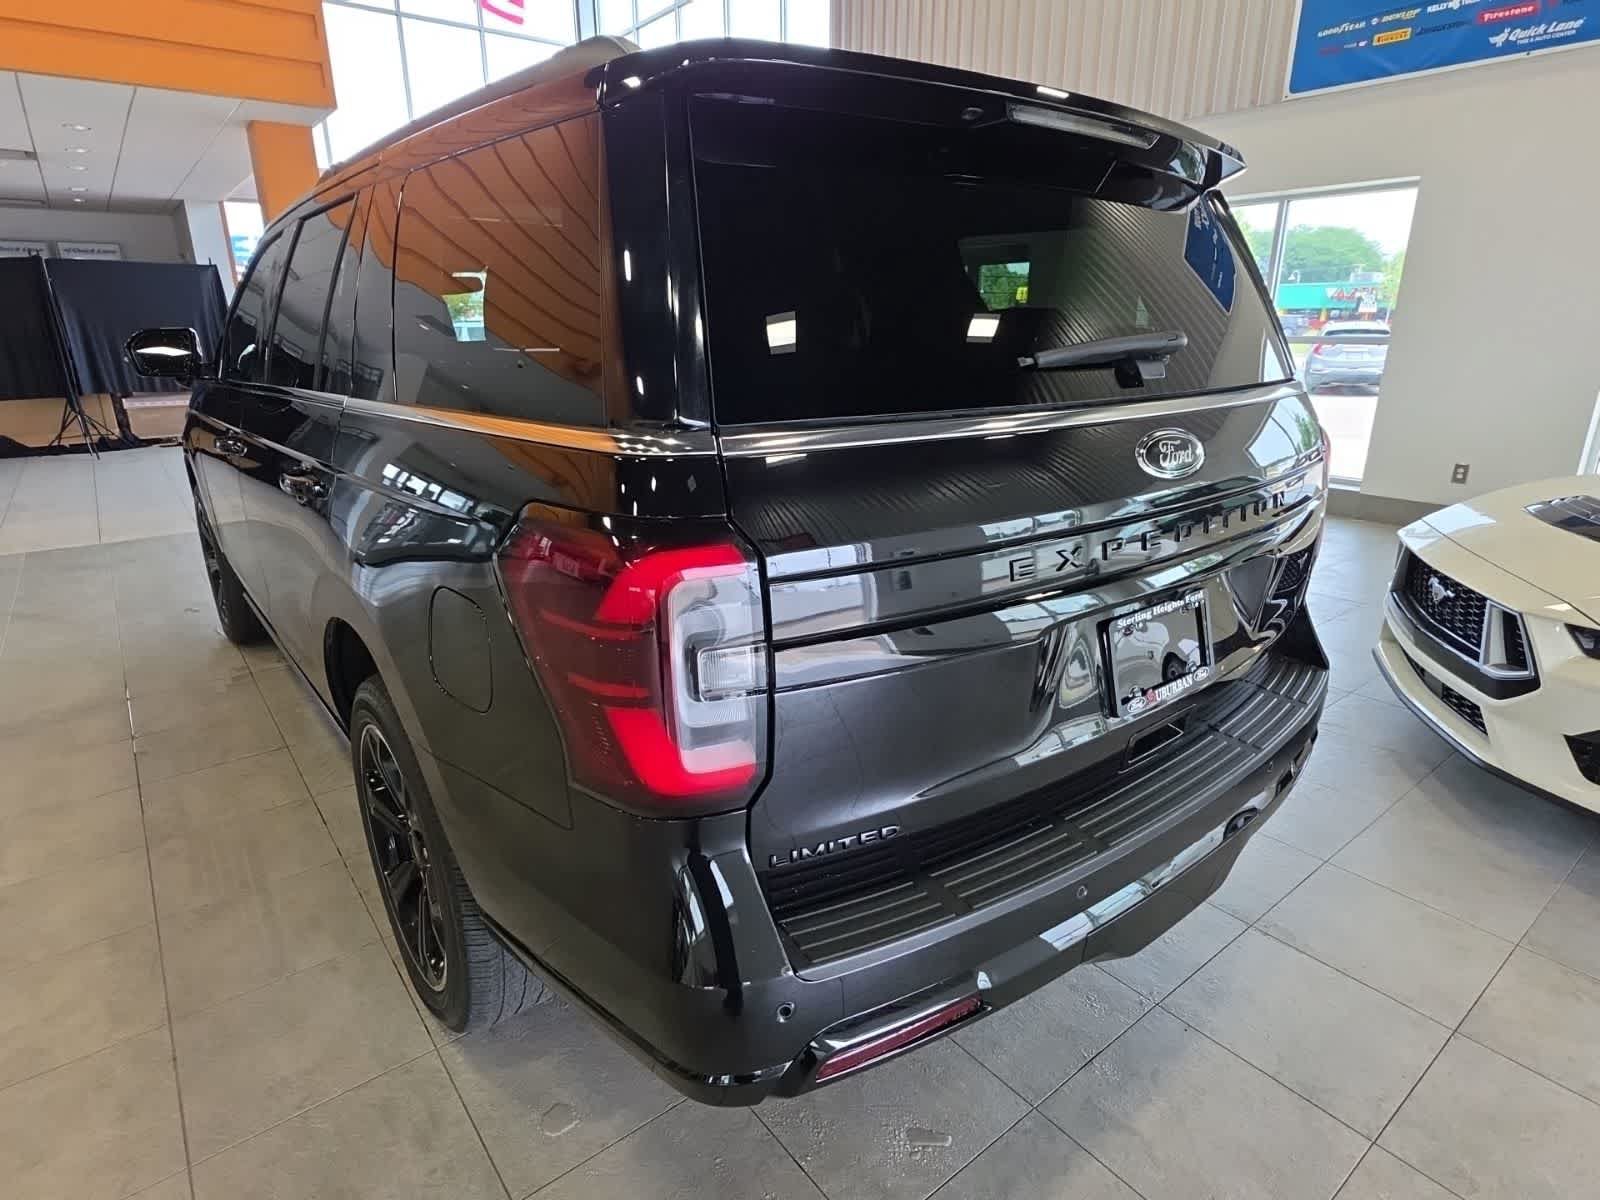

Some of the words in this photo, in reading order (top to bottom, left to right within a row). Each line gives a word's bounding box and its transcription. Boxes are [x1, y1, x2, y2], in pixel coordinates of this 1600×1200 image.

[1483, 5, 1535, 22] Firestone
[1317, 21, 1366, 38] GOODYEAR
[1508, 23, 1548, 41] Quick
[1547, 18, 1584, 33] Lane
[1158, 440, 1194, 468] Ford
[1009, 491, 1285, 582] EXPEDITION
[1116, 610, 1153, 629] Sterling
[1153, 599, 1185, 616] Heights
[1184, 590, 1205, 604] Ford
[769, 825, 901, 868] LIMITED
